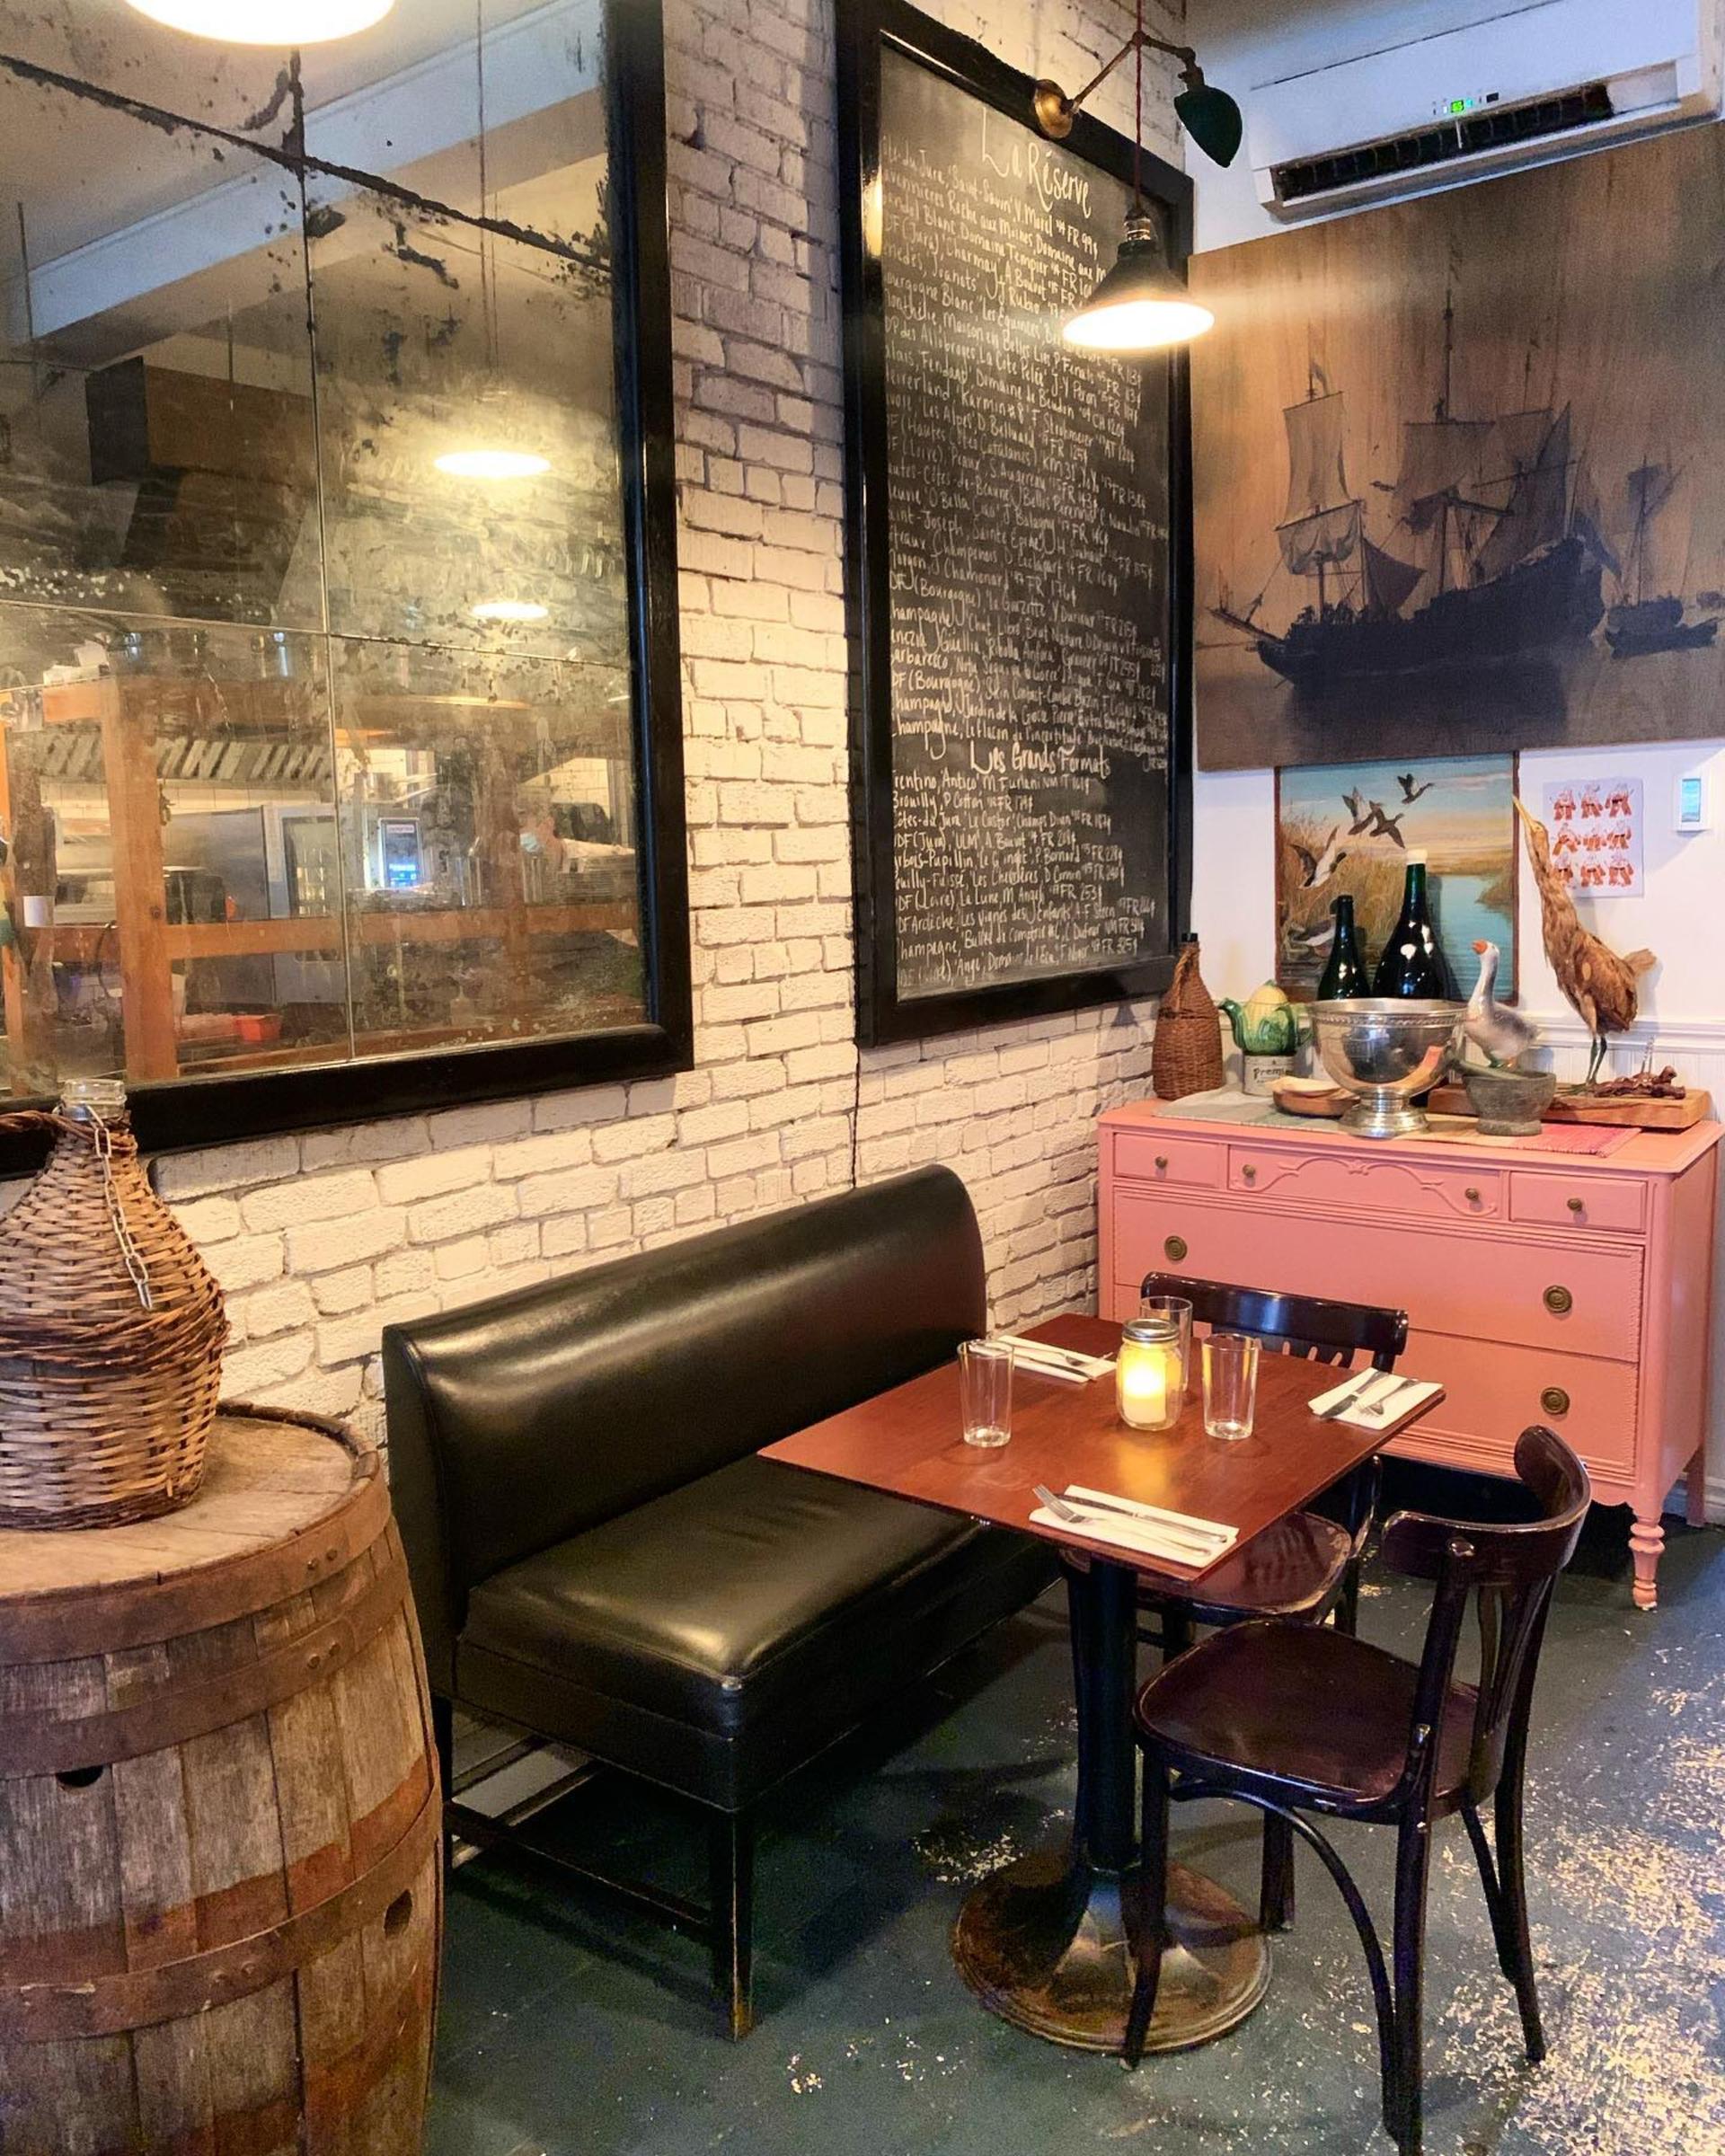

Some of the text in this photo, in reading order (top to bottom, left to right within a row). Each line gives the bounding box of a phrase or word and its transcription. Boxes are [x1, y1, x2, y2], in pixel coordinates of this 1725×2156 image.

[981, 106, 1022, 177] La
[1029, 142, 1092, 219] Réserve
[886, 271, 938, 321] ourgogne
[969, 740, 1006, 774] Les
[1012, 742, 1057, 774] Grands
[1057, 746, 1110, 780] Formats
